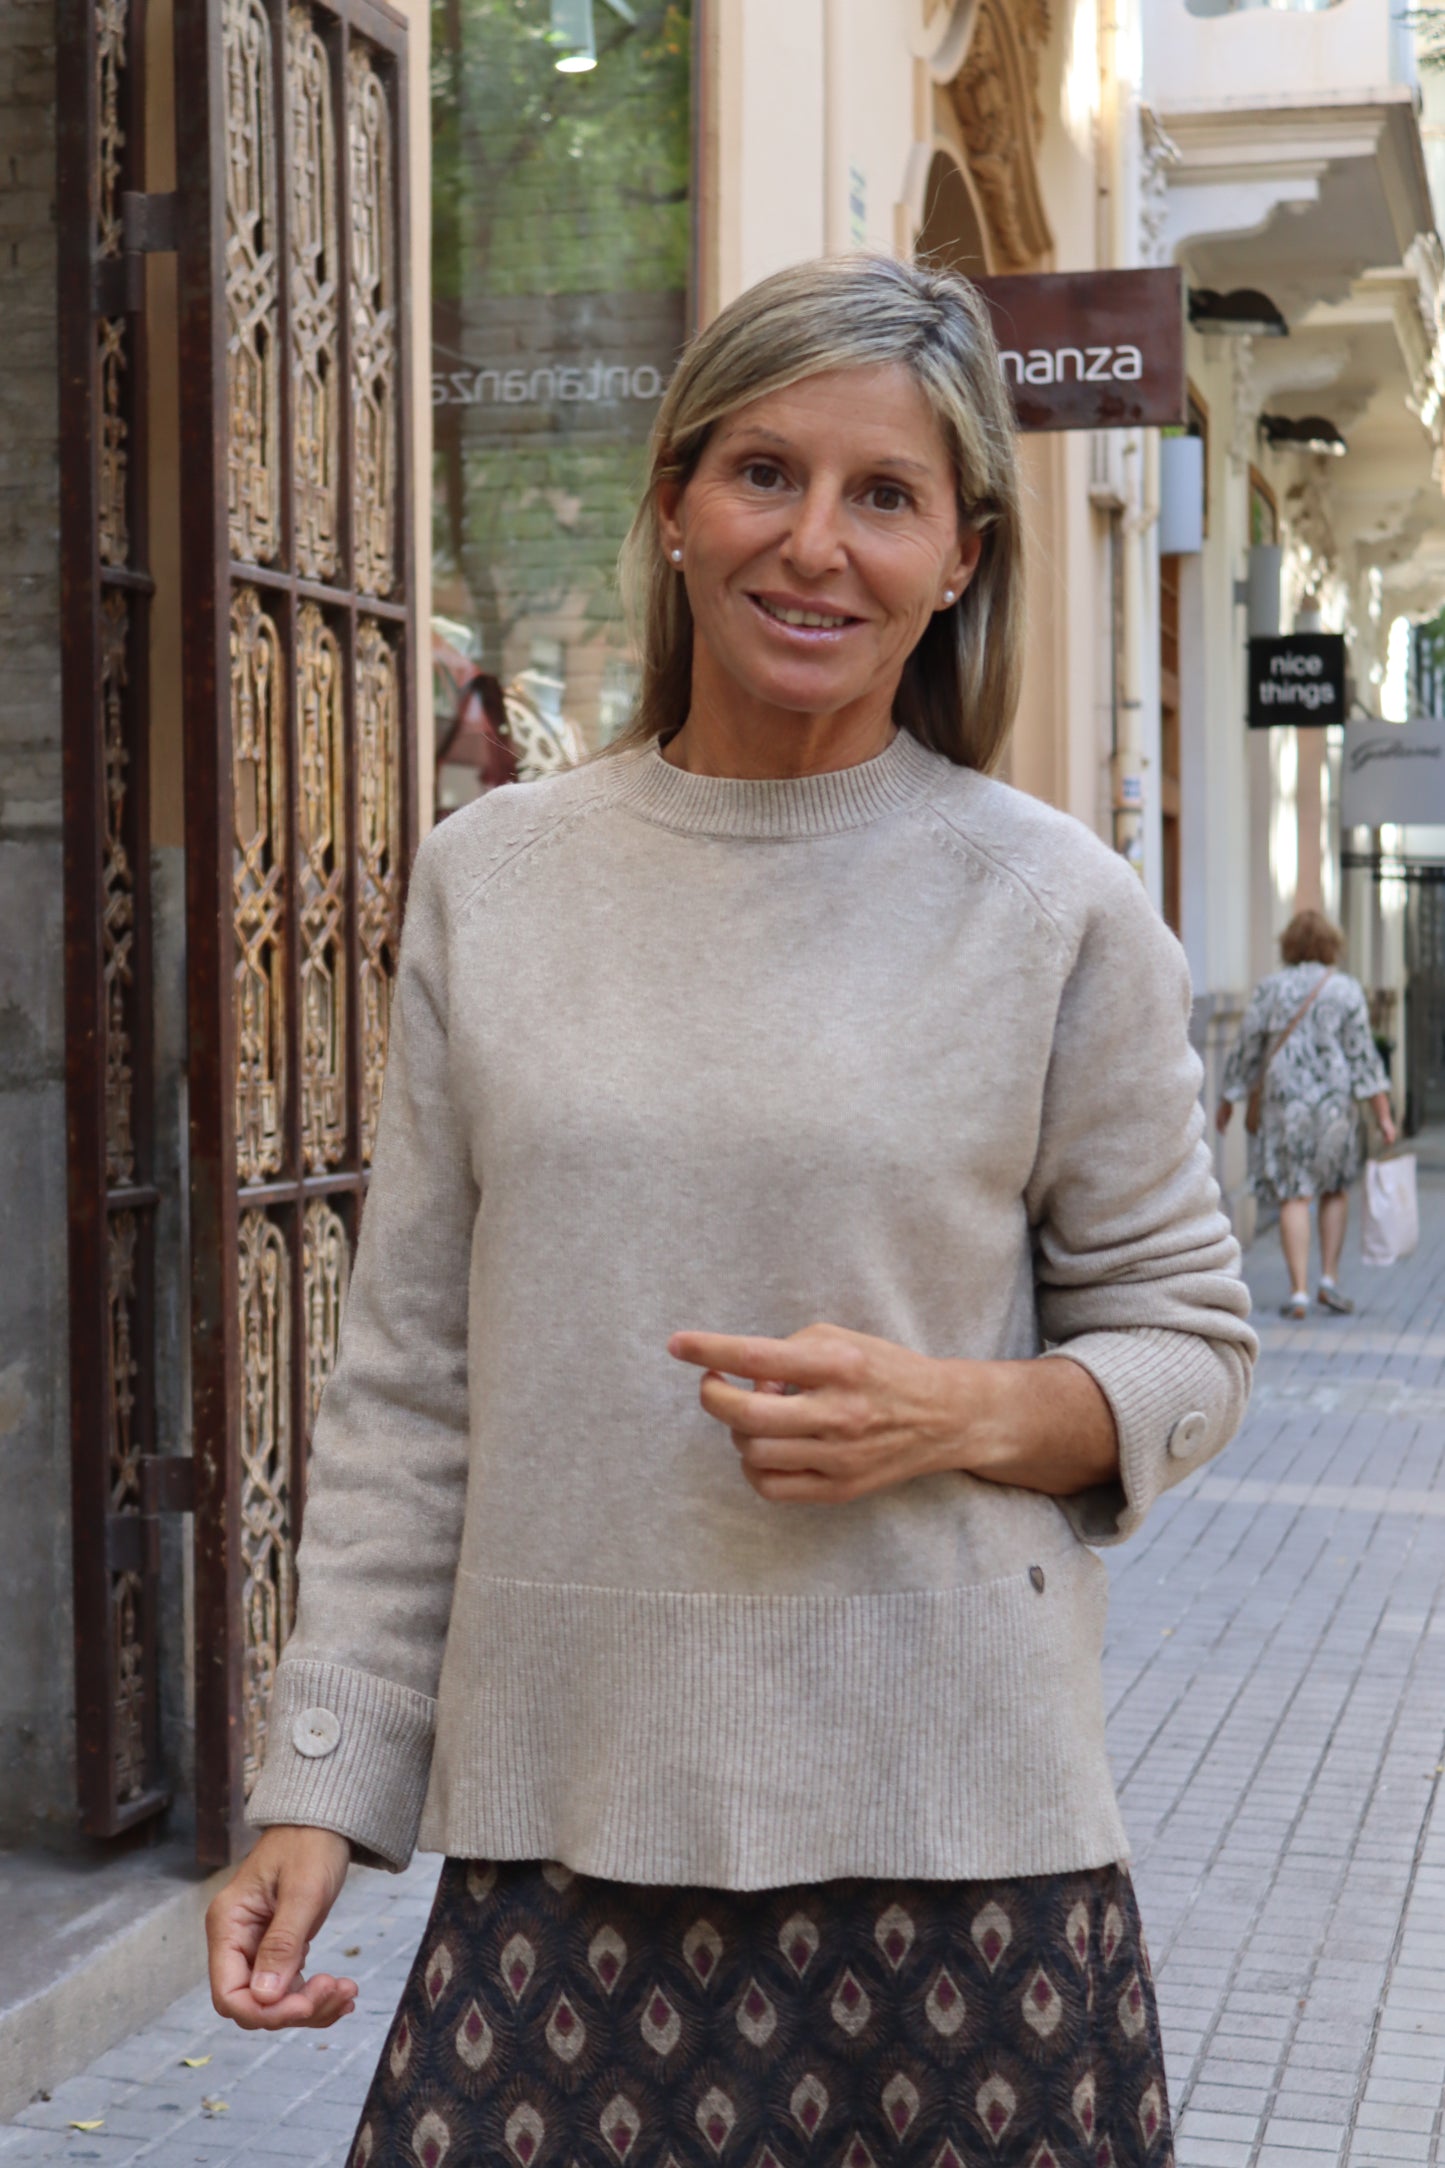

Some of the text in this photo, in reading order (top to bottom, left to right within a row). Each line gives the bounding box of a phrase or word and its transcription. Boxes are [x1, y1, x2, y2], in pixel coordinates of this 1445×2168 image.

[998, 344, 1143, 384] nanza
[1270, 653, 1323, 676] nice
[1259, 679, 1335, 710] things
